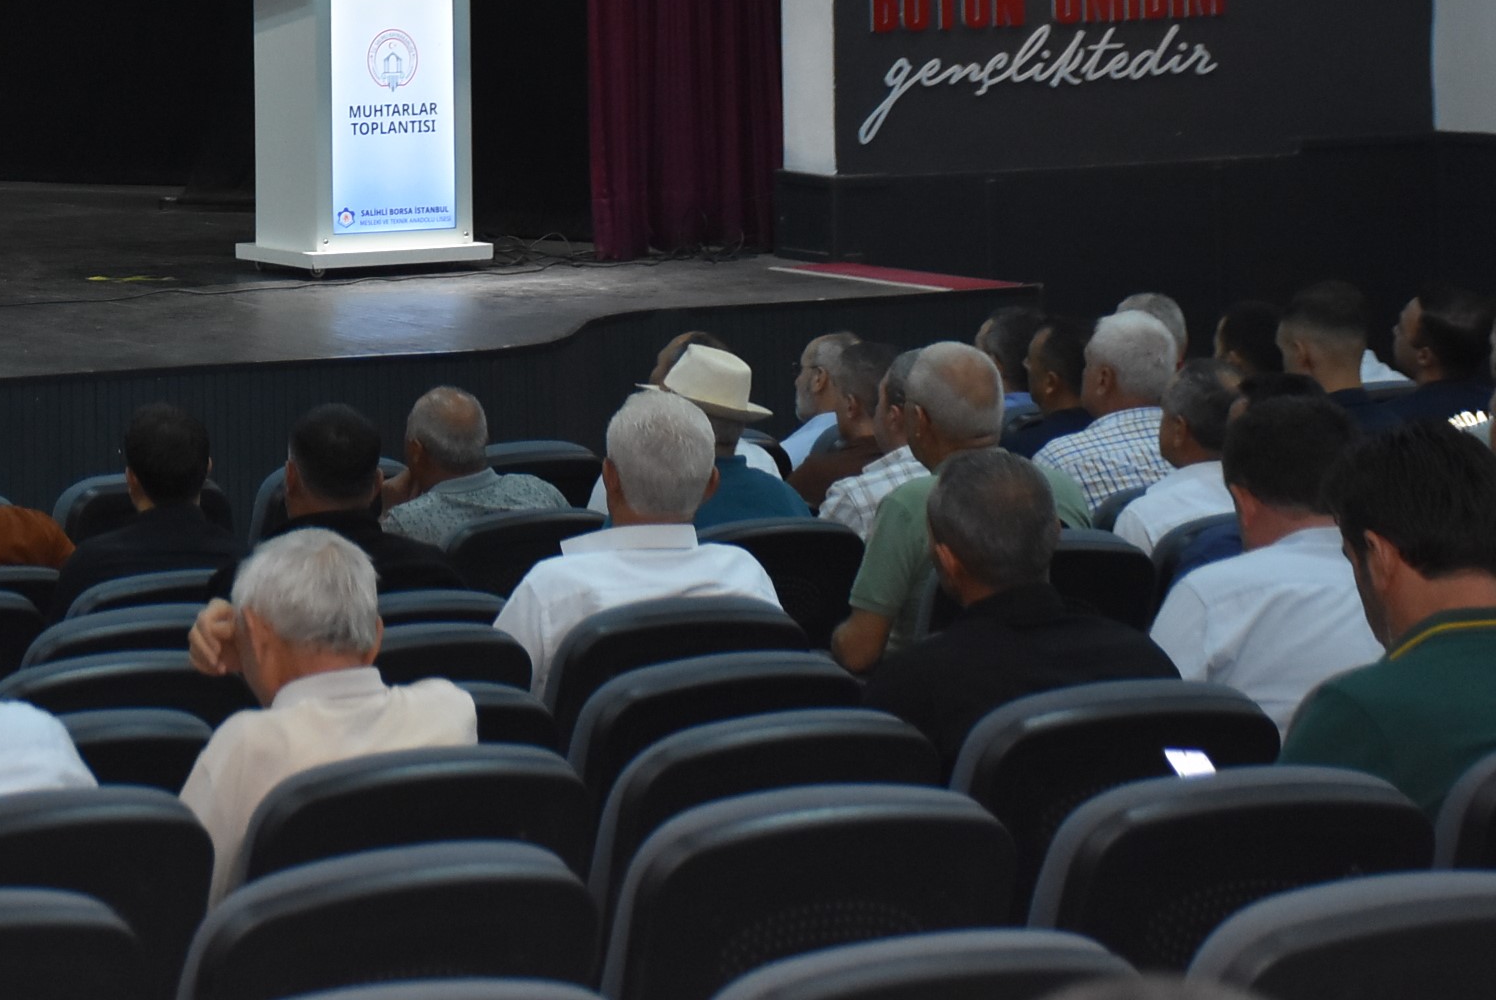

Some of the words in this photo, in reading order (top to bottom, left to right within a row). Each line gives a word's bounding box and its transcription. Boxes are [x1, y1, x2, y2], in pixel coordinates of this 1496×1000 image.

[858, 24, 1218, 144] gençliktedir
[349, 102, 438, 118] MUHTARLAR
[350, 119, 436, 136] TOPLANTISI
[360, 208, 388, 217] SALİHLİ
[389, 207, 413, 216] BORSA
[414, 205, 449, 214] İSTANBUL
